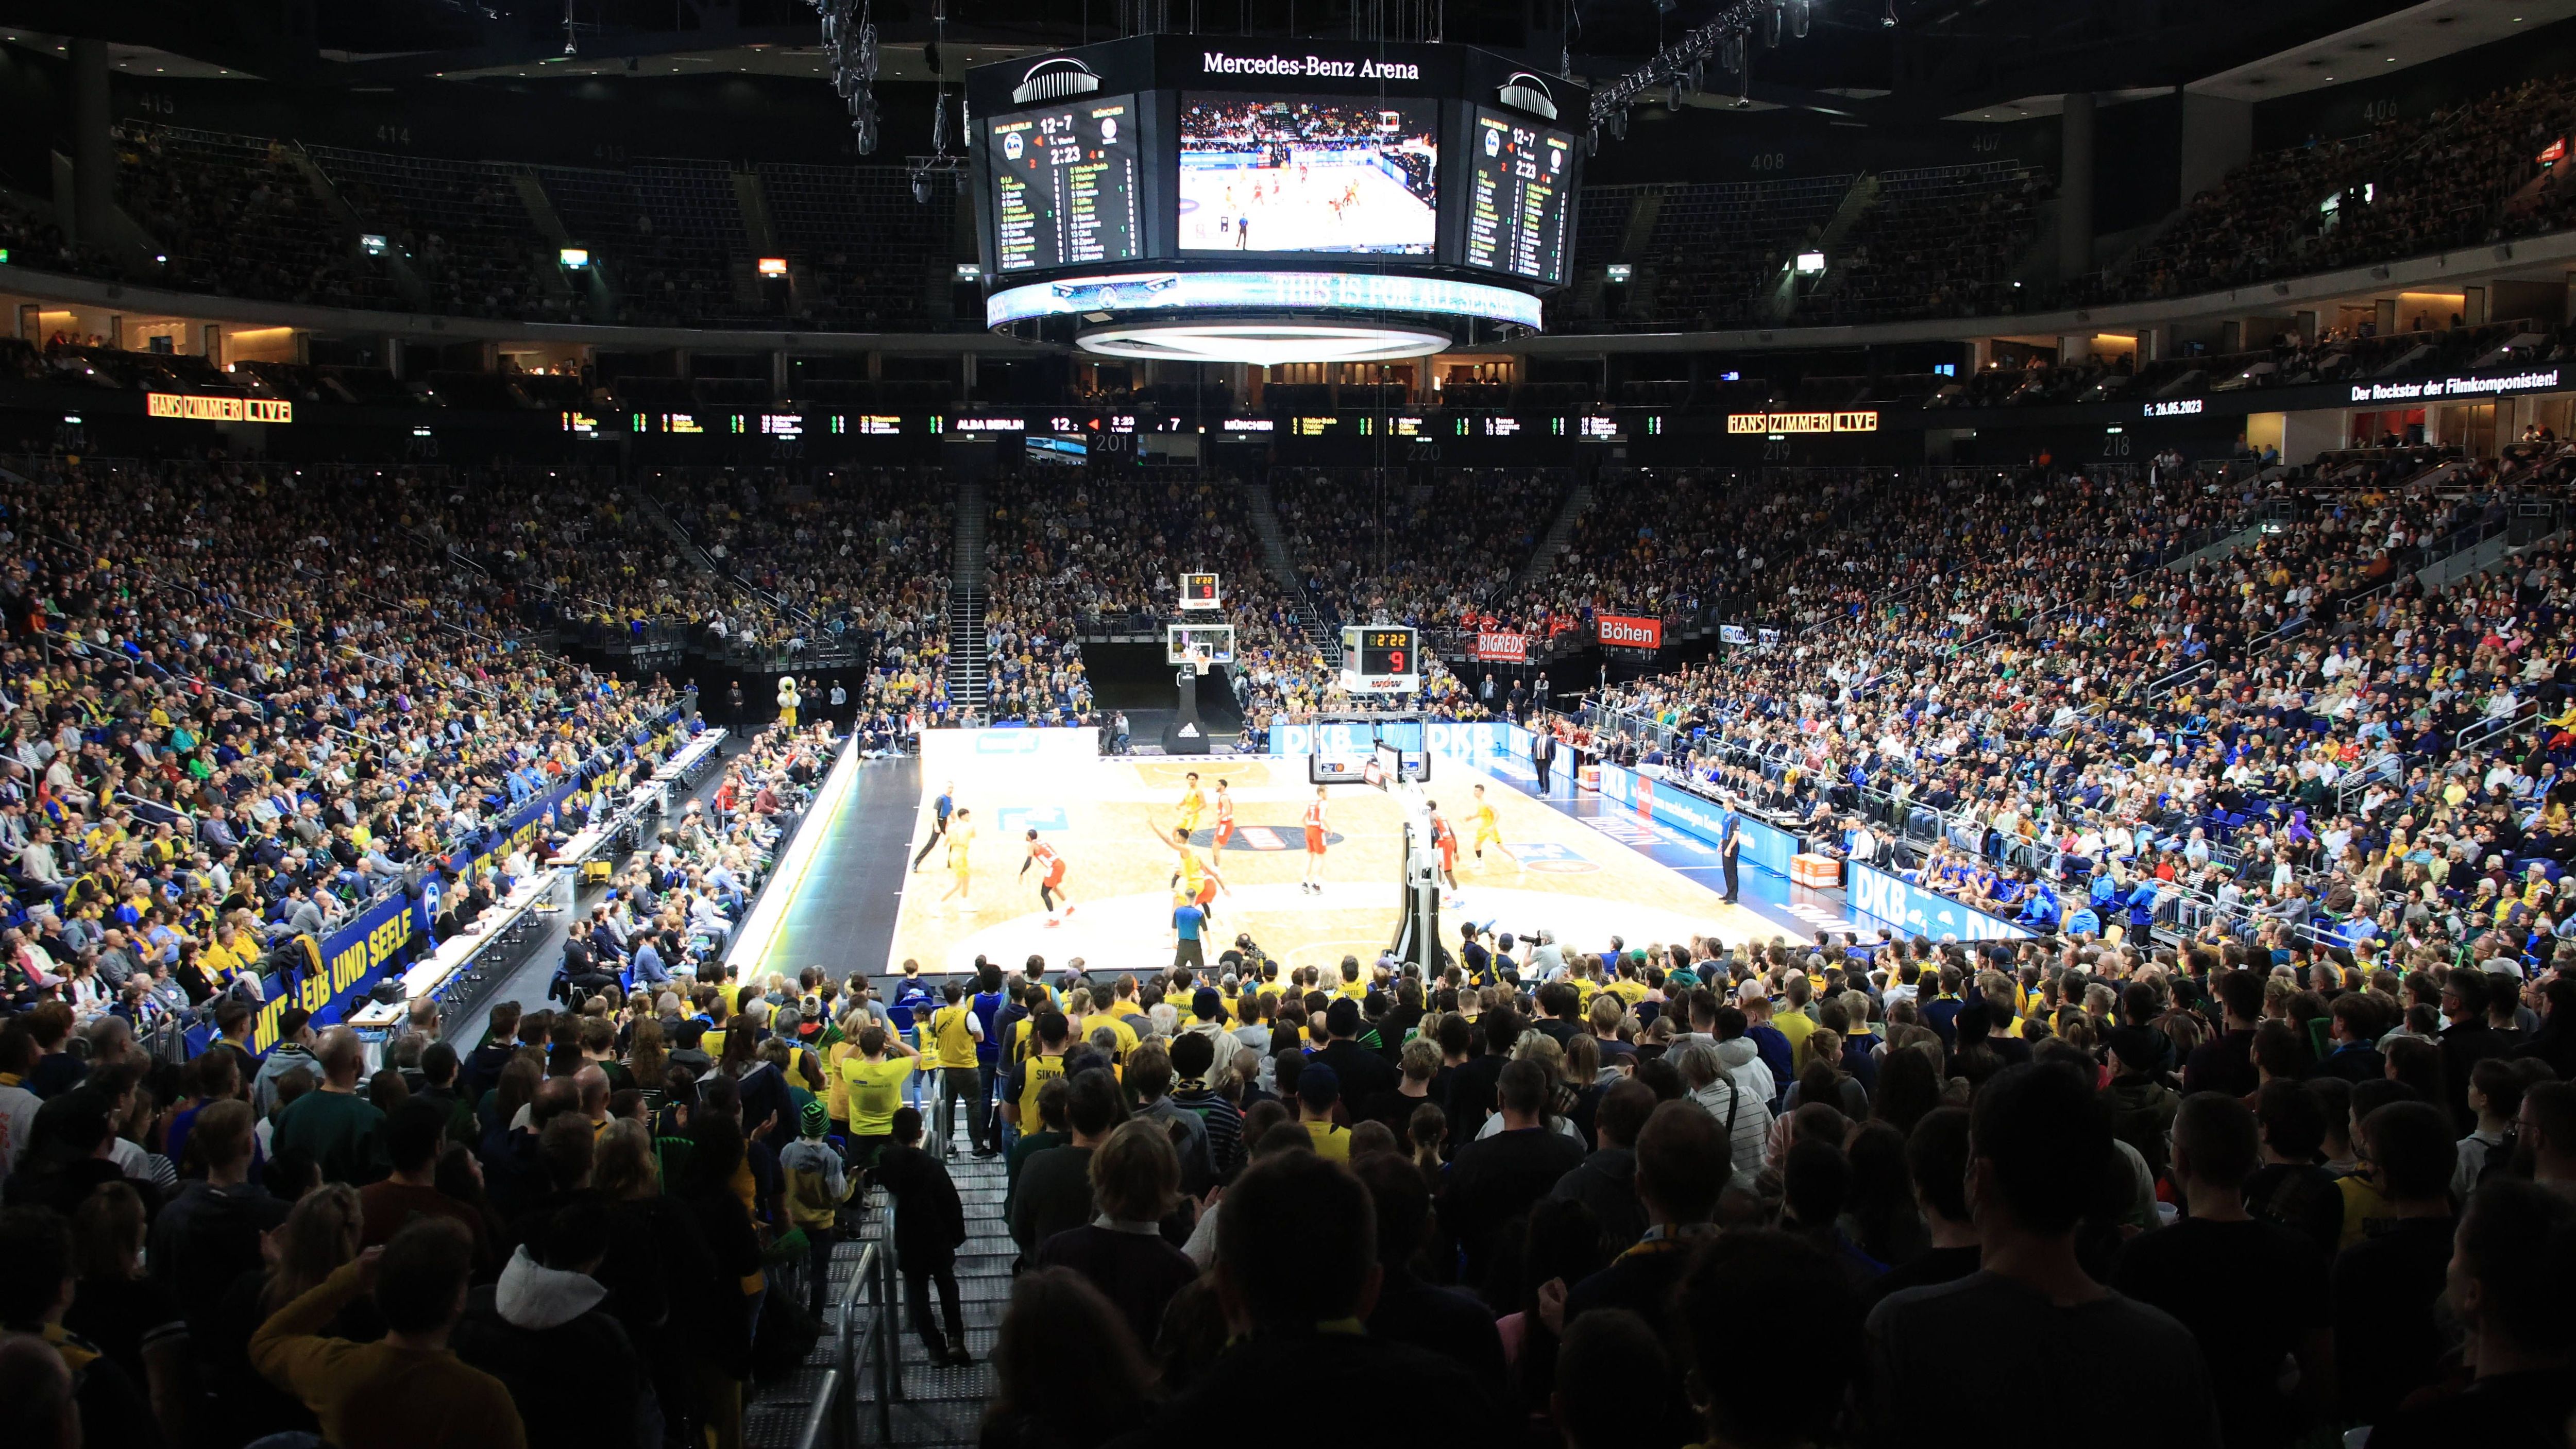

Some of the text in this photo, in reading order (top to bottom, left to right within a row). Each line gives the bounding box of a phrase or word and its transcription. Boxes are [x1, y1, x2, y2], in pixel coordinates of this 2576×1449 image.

[1204, 53, 1419, 79] Mercedes-Benz Arena
[1092, 106, 1124, 118] MÜNCHEN
[2364, 98, 2397, 122] 406
[995, 122, 1032, 134] ALBA BERLIN
[1041, 114, 1072, 134] 12-7
[1029, 158, 1036, 168] 2
[1051, 146, 1080, 165] 2:23
[1089, 150, 1096, 159] 4
[1751, 153, 1784, 170] 408
[1501, 162, 1506, 172] 2
[1516, 160, 1536, 179] 2:23
[1541, 174, 1546, 182] 4
[1272, 275, 1331, 304] THIS
[1339, 277, 1360, 304] IS
[1369, 278, 1414, 306] FOR
[1419, 281, 1455, 308] ALL
[2352, 370, 2557, 401] Der Rockstar der Filmkomponisten!
[150, 394, 291, 421] HANS ZIMMER LIVE
[2144, 400, 2202, 417] Fr. 26.05.2023
[957, 420, 1024, 431] ALBA BERLIN
[1051, 418, 1070, 431] 12
[1171, 418, 1180, 430] 7
[1225, 419, 1273, 431] MÜNCHEN
[1730, 413, 1876, 432] HANS ZIMMER LIVE
[1096, 435, 1128, 452] 201
[1763, 442, 1791, 461] 219
[2103, 436, 2130, 456] 218
[1407, 444, 1440, 462] 220
[1204, 585, 1212, 598] 9
[1377, 634, 1406, 647] 2:22
[1601, 622, 1652, 642] Böhen
[1479, 635, 1524, 653] BIGREDS
[1391, 652, 1403, 672] 9
[1428, 723, 1494, 751] DKB
[1601, 762, 1627, 803] DKB
[1577, 816, 1671, 845] BERLIN
[1856, 865, 1906, 926] DKB
[254, 907, 412, 1055] MIT EIB UND SEELE
[927, 1042, 934, 1054] 7
